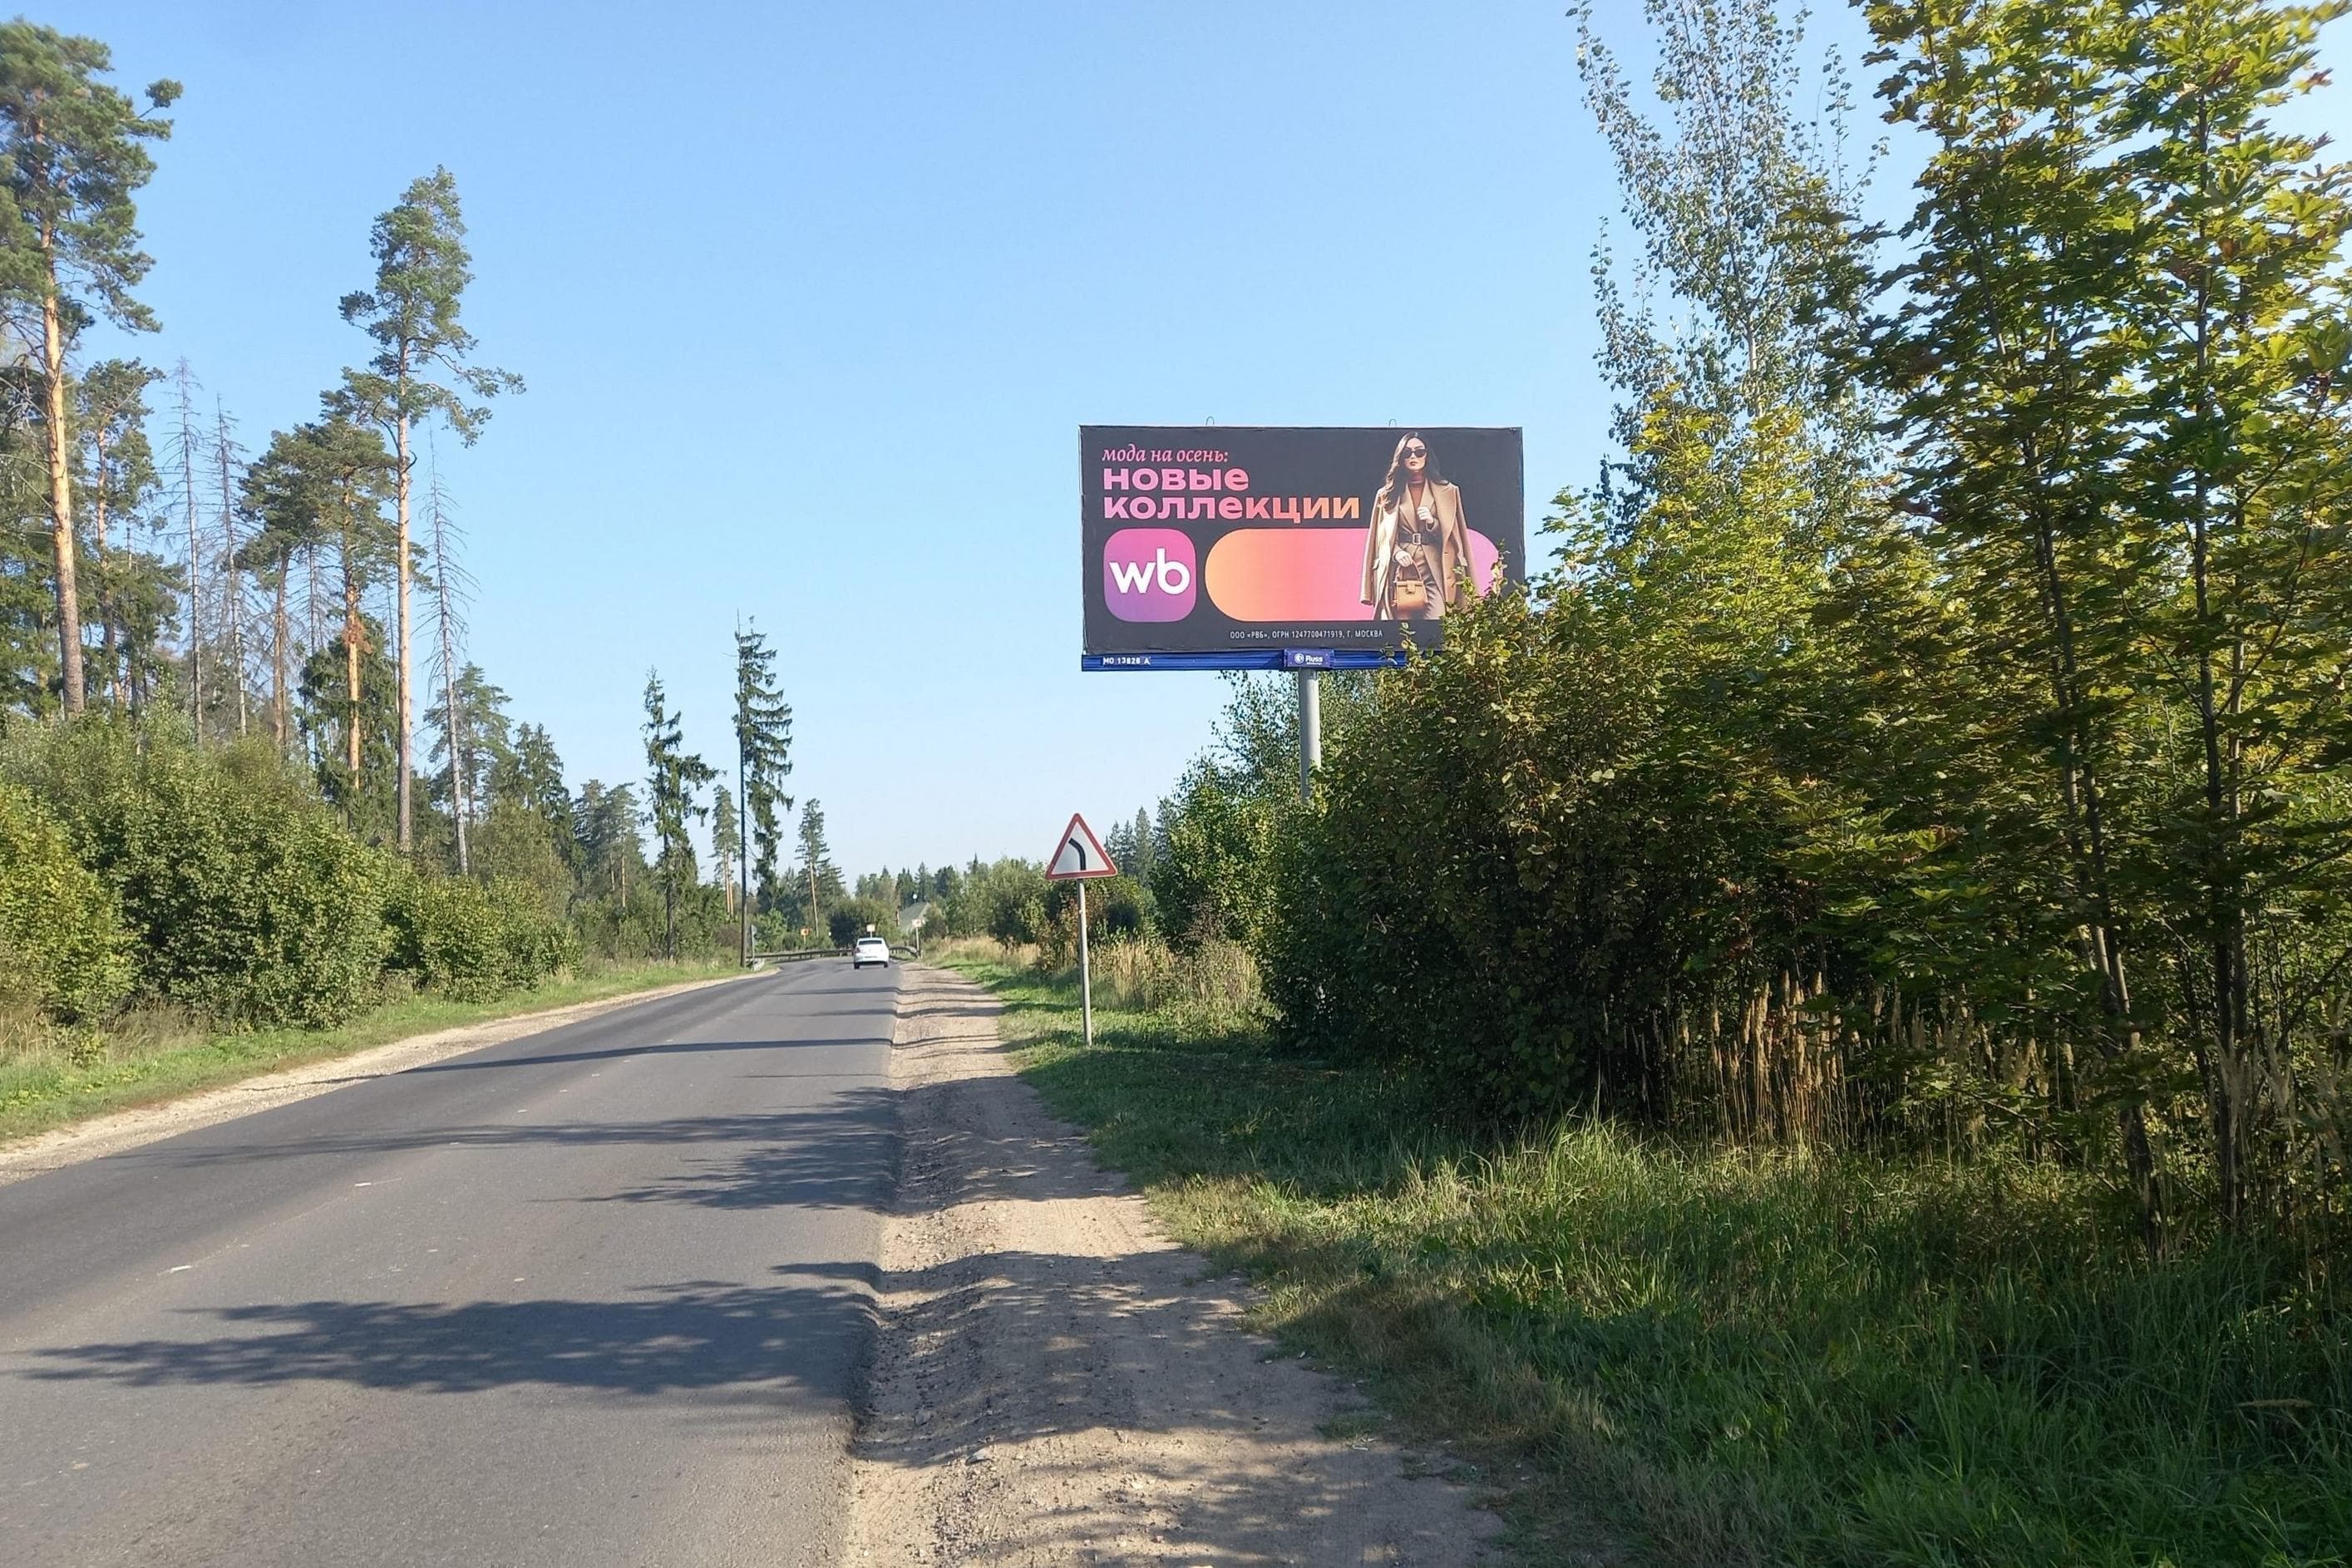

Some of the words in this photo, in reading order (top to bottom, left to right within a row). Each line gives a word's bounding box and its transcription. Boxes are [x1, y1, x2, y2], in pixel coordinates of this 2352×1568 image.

[1102, 443, 1146, 462] мода
[1151, 450, 1172, 462] на
[1176, 450, 1229, 462] осень:
[1103, 467, 1250, 491] новые
[1103, 496, 1360, 524] коллекции
[1109, 547, 1191, 595] wb
[1230, 631, 1245, 639] ООО
[1272, 630, 1289, 639] ОГРН
[1355, 629, 1383, 639] МОСКВА
